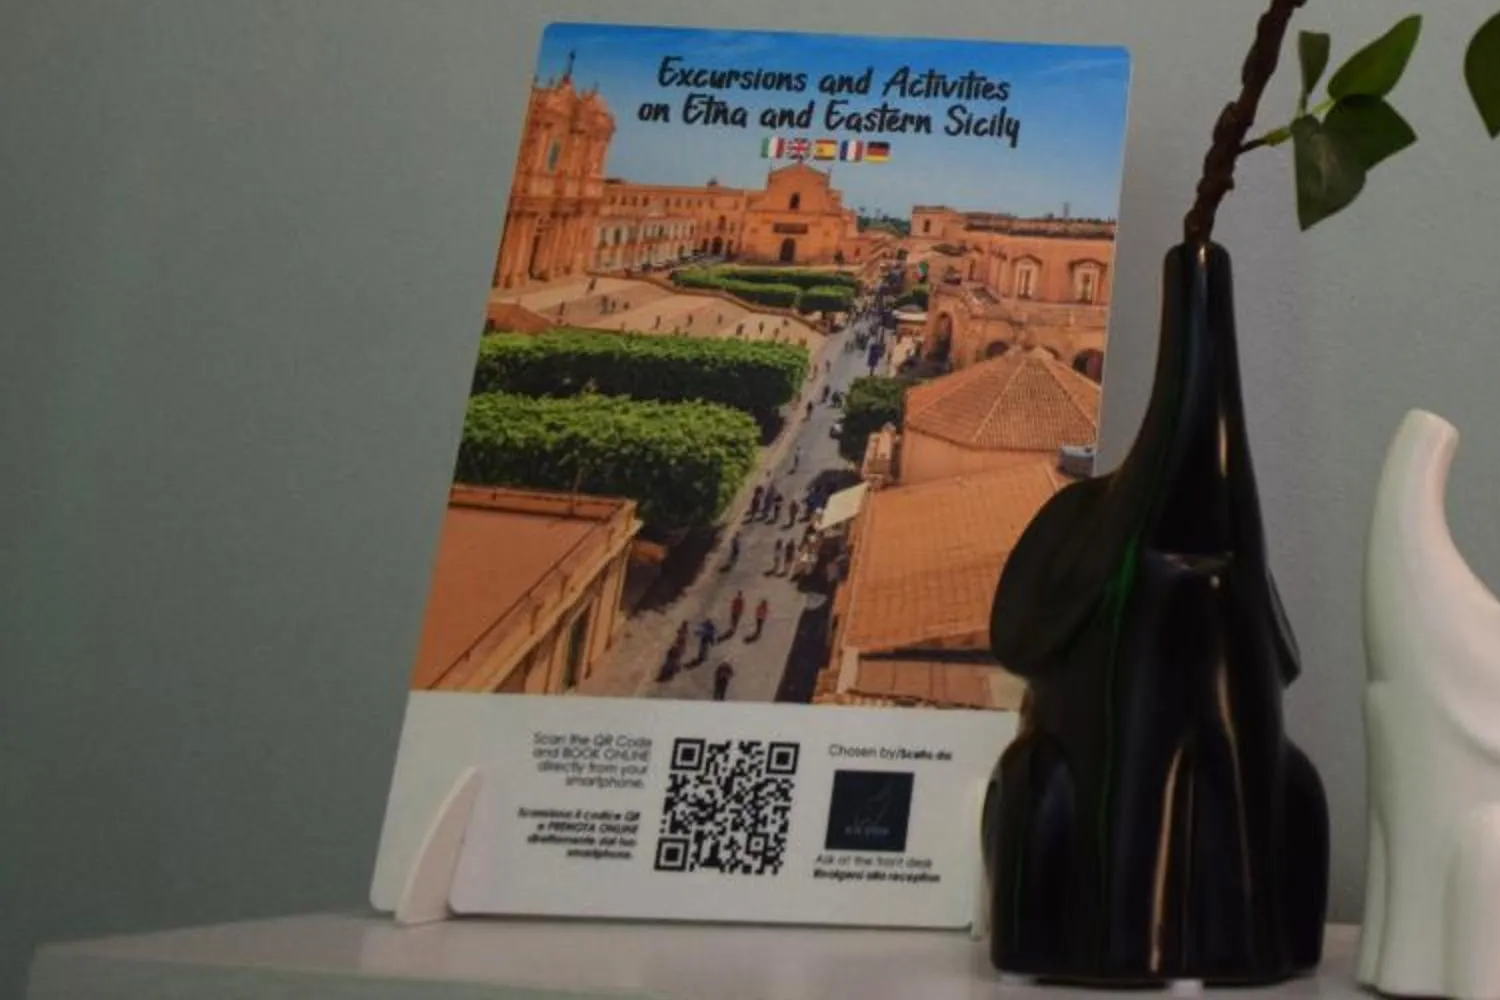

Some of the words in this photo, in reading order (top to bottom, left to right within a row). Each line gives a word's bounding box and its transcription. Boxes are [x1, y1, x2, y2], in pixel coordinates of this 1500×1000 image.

[657, 55, 807, 94] Excursions
[819, 66, 874, 97] and
[881, 65, 1011, 102] Activities
[638, 101, 671, 125] on
[681, 94, 747, 130] Etna
[760, 99, 816, 131] and
[825, 99, 933, 135] Eastern
[944, 105, 1021, 149] Sicily
[533, 731, 565, 746] Scan
[569, 733, 590, 746] the
[593, 734, 614, 748] QR
[615, 734, 653, 749] Code
[532, 747, 559, 760] and
[828, 743, 878, 759] Chosen
